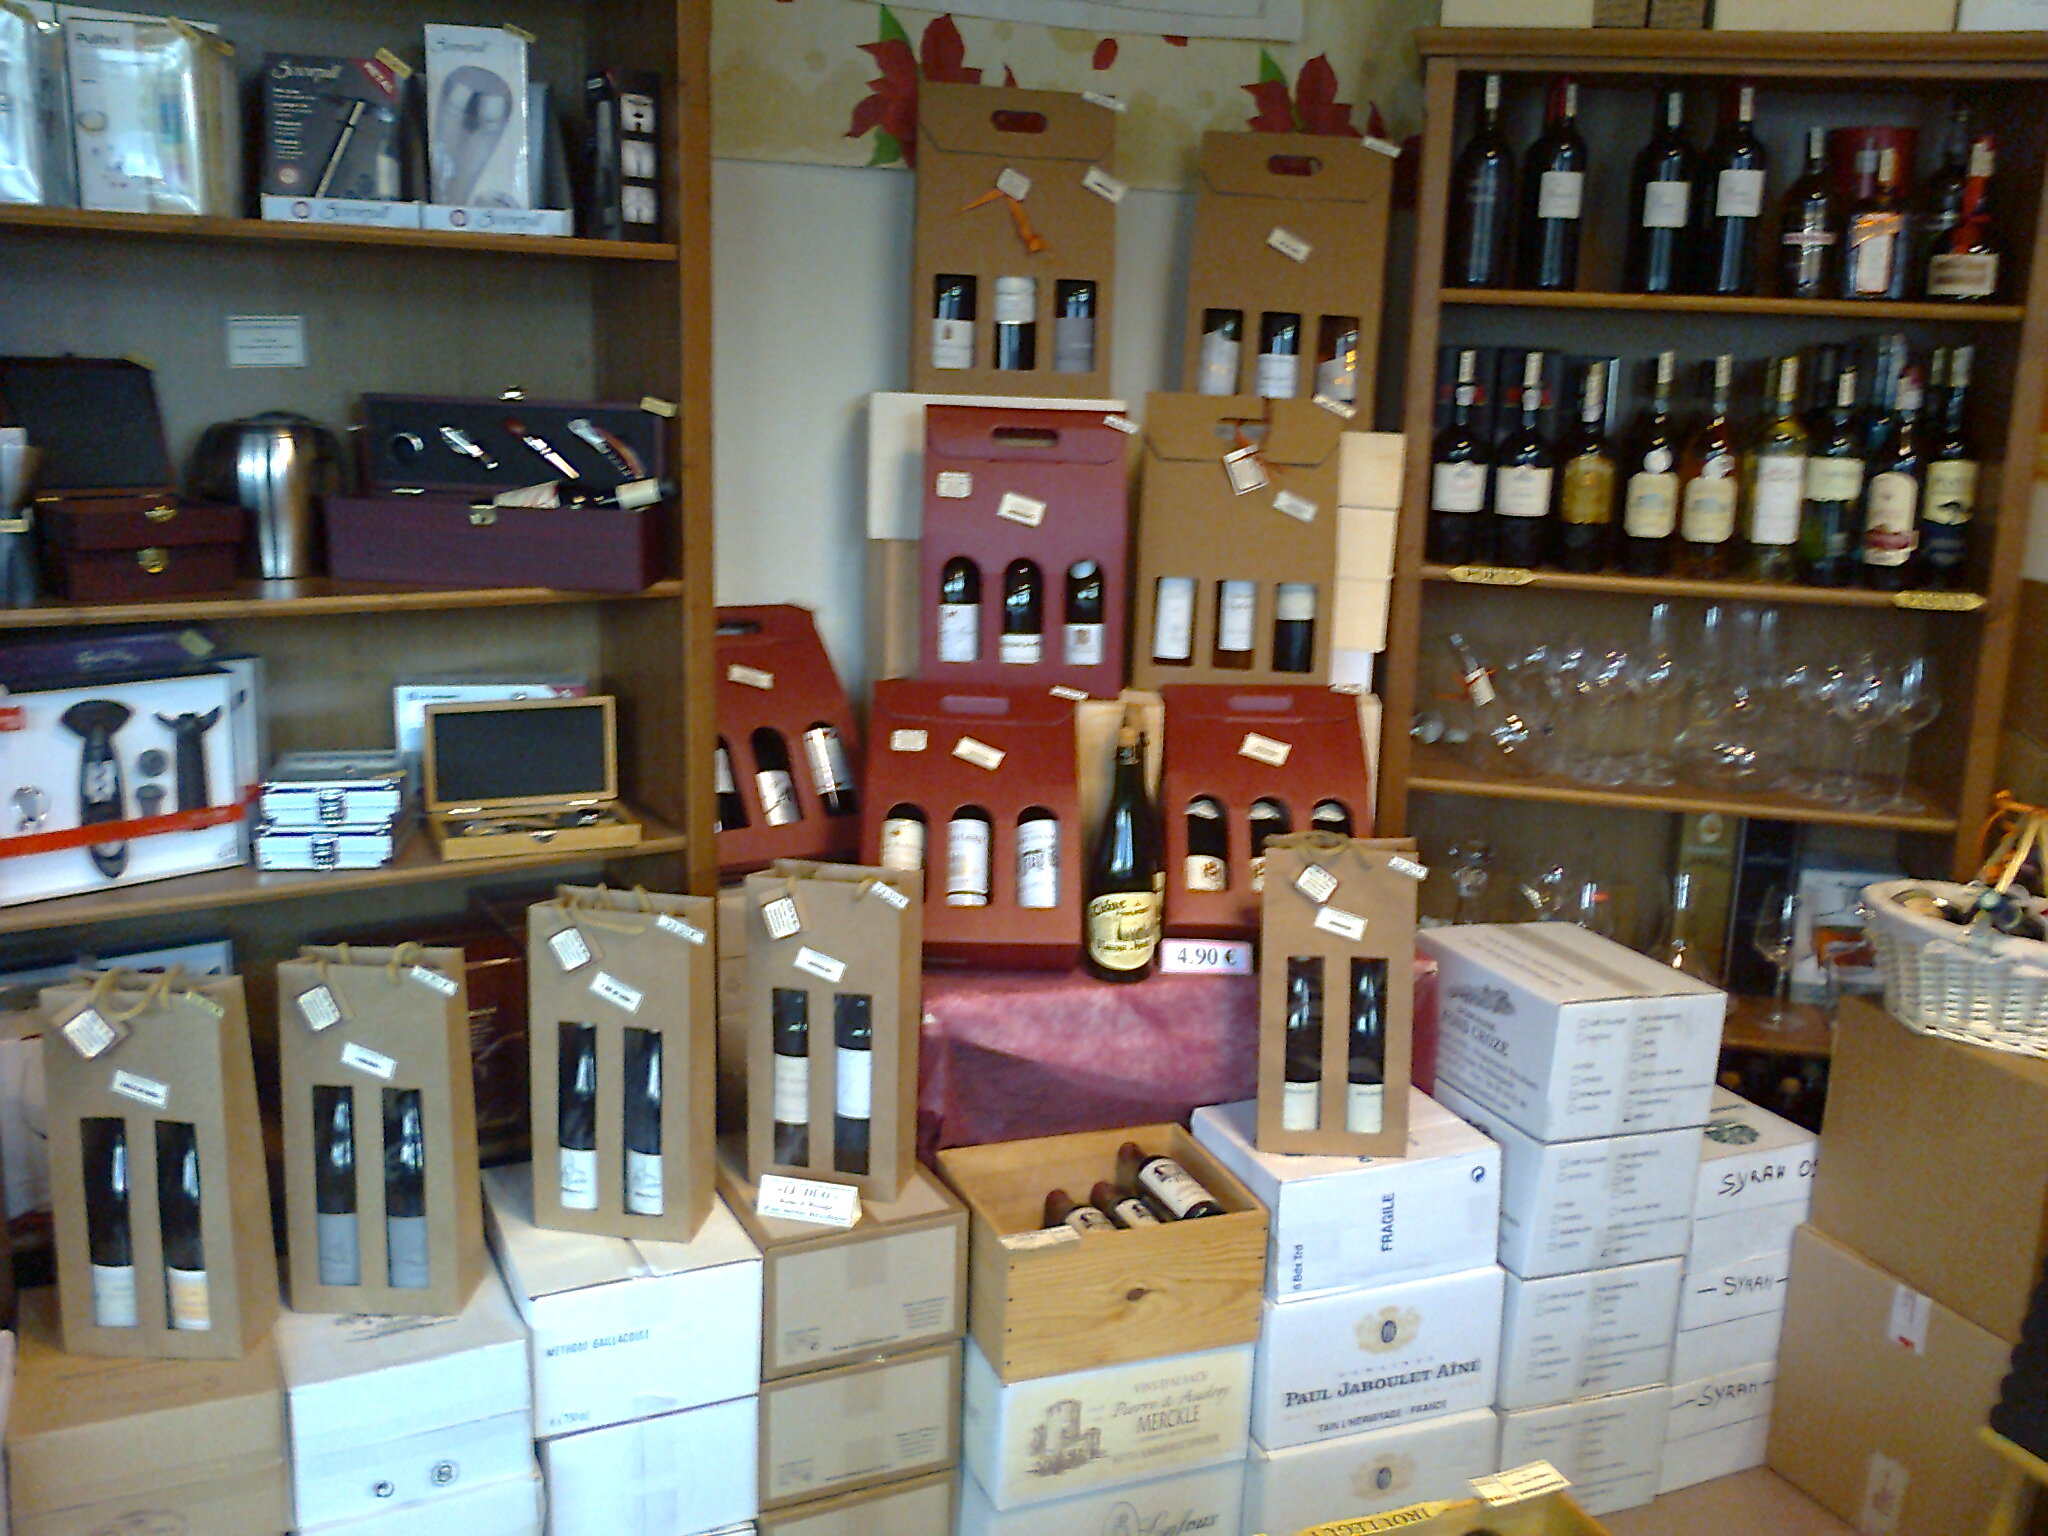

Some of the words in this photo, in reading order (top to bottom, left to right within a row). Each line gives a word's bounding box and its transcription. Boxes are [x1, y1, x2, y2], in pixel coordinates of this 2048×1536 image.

[1177, 947, 1218, 965] 4.90
[1224, 948, 1237, 966] €
[1381, 1192, 1395, 1251] FRAGILE
[1285, 1389, 1333, 1407] PAUL
[1337, 1370, 1431, 1397] JABOULET
[1136, 1405, 1200, 1434] MERCKLE
